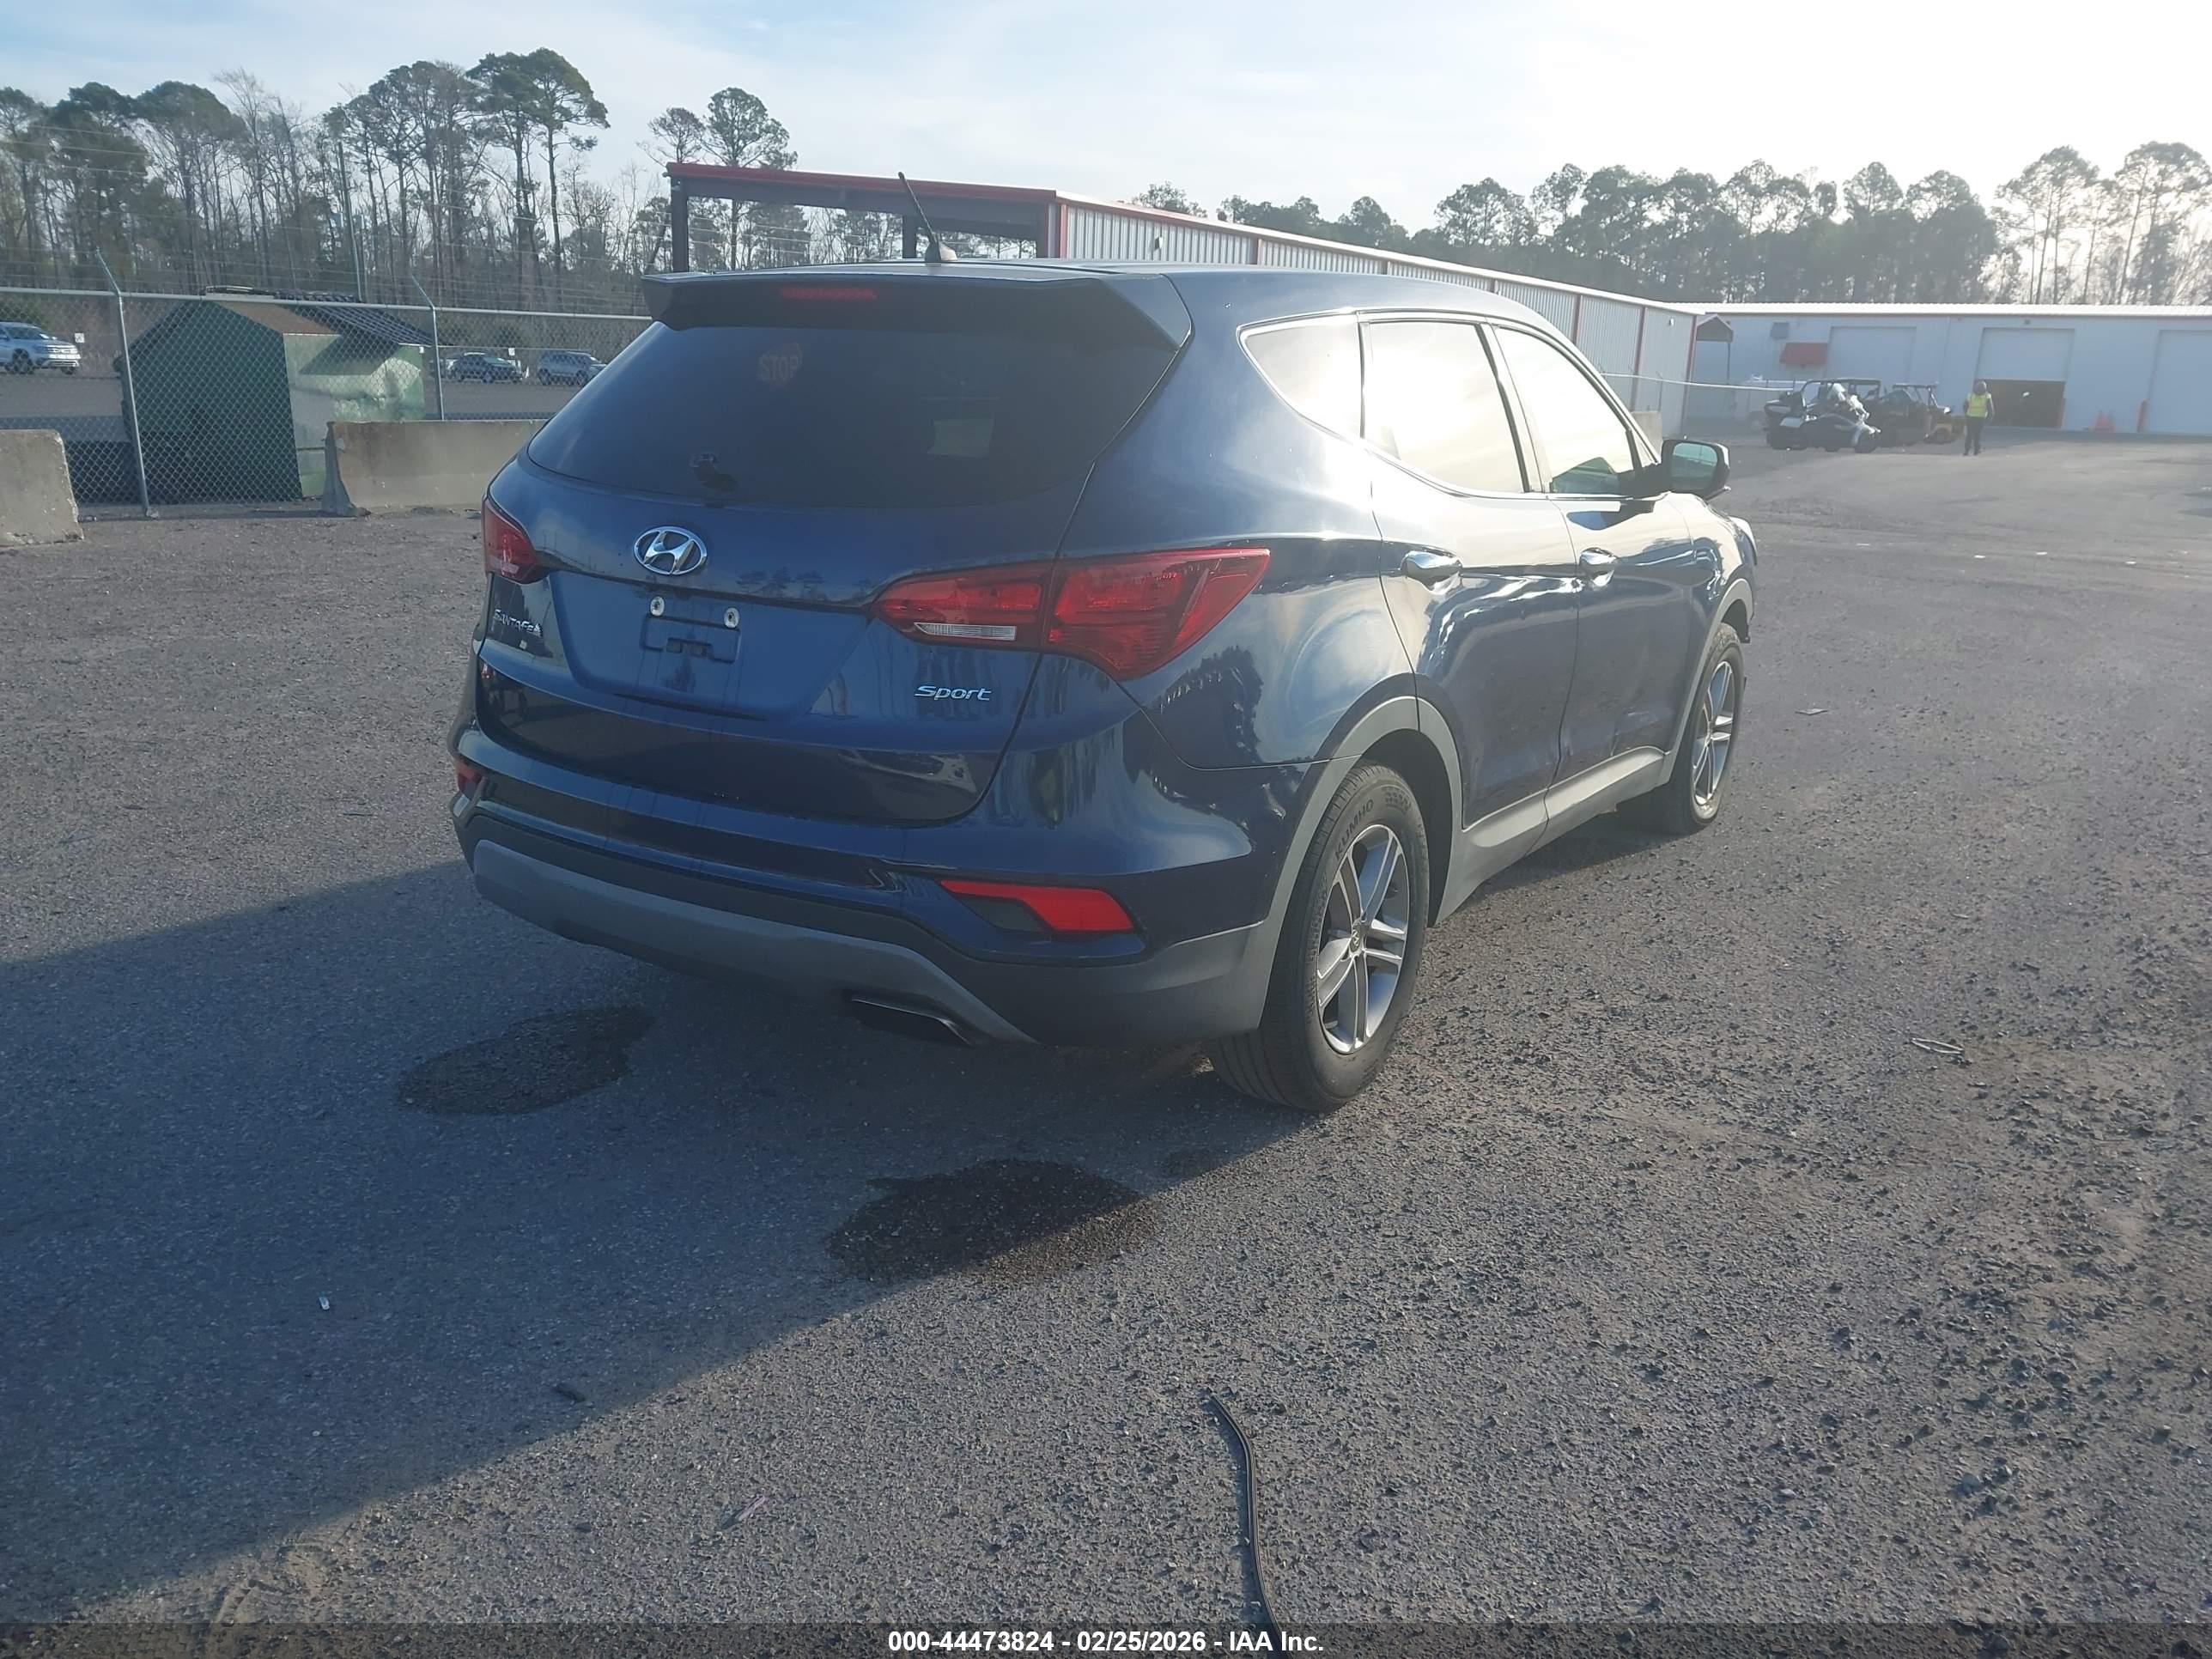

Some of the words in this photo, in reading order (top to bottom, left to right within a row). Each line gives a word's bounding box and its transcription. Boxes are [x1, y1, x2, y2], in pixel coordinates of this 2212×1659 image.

[759, 354, 799, 380] STOP
[914, 685, 992, 701] Sport
[1334, 799, 1374, 860] KUMHO
